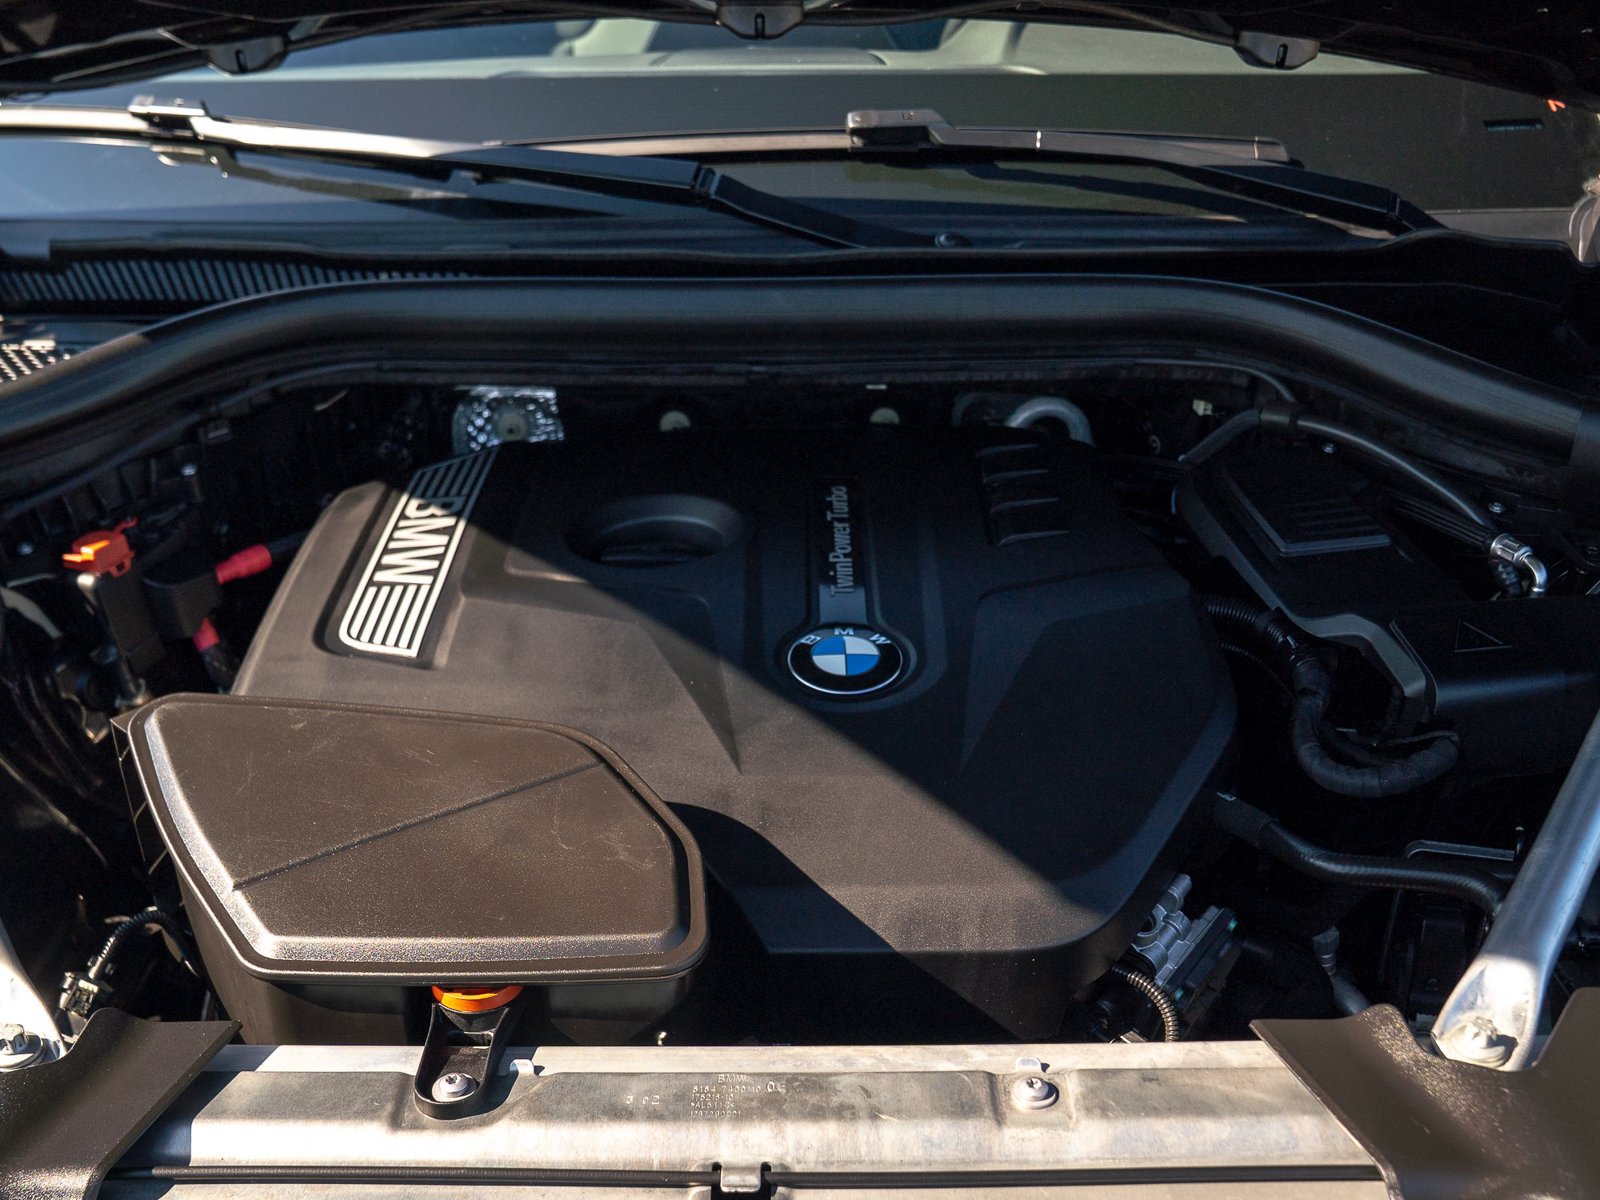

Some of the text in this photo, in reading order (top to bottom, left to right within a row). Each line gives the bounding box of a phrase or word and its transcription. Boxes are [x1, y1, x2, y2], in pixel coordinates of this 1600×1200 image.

[372, 497, 468, 585] BMW
[826, 485, 854, 597] TwinPower Turbo
[800, 626, 892, 646] BMW
